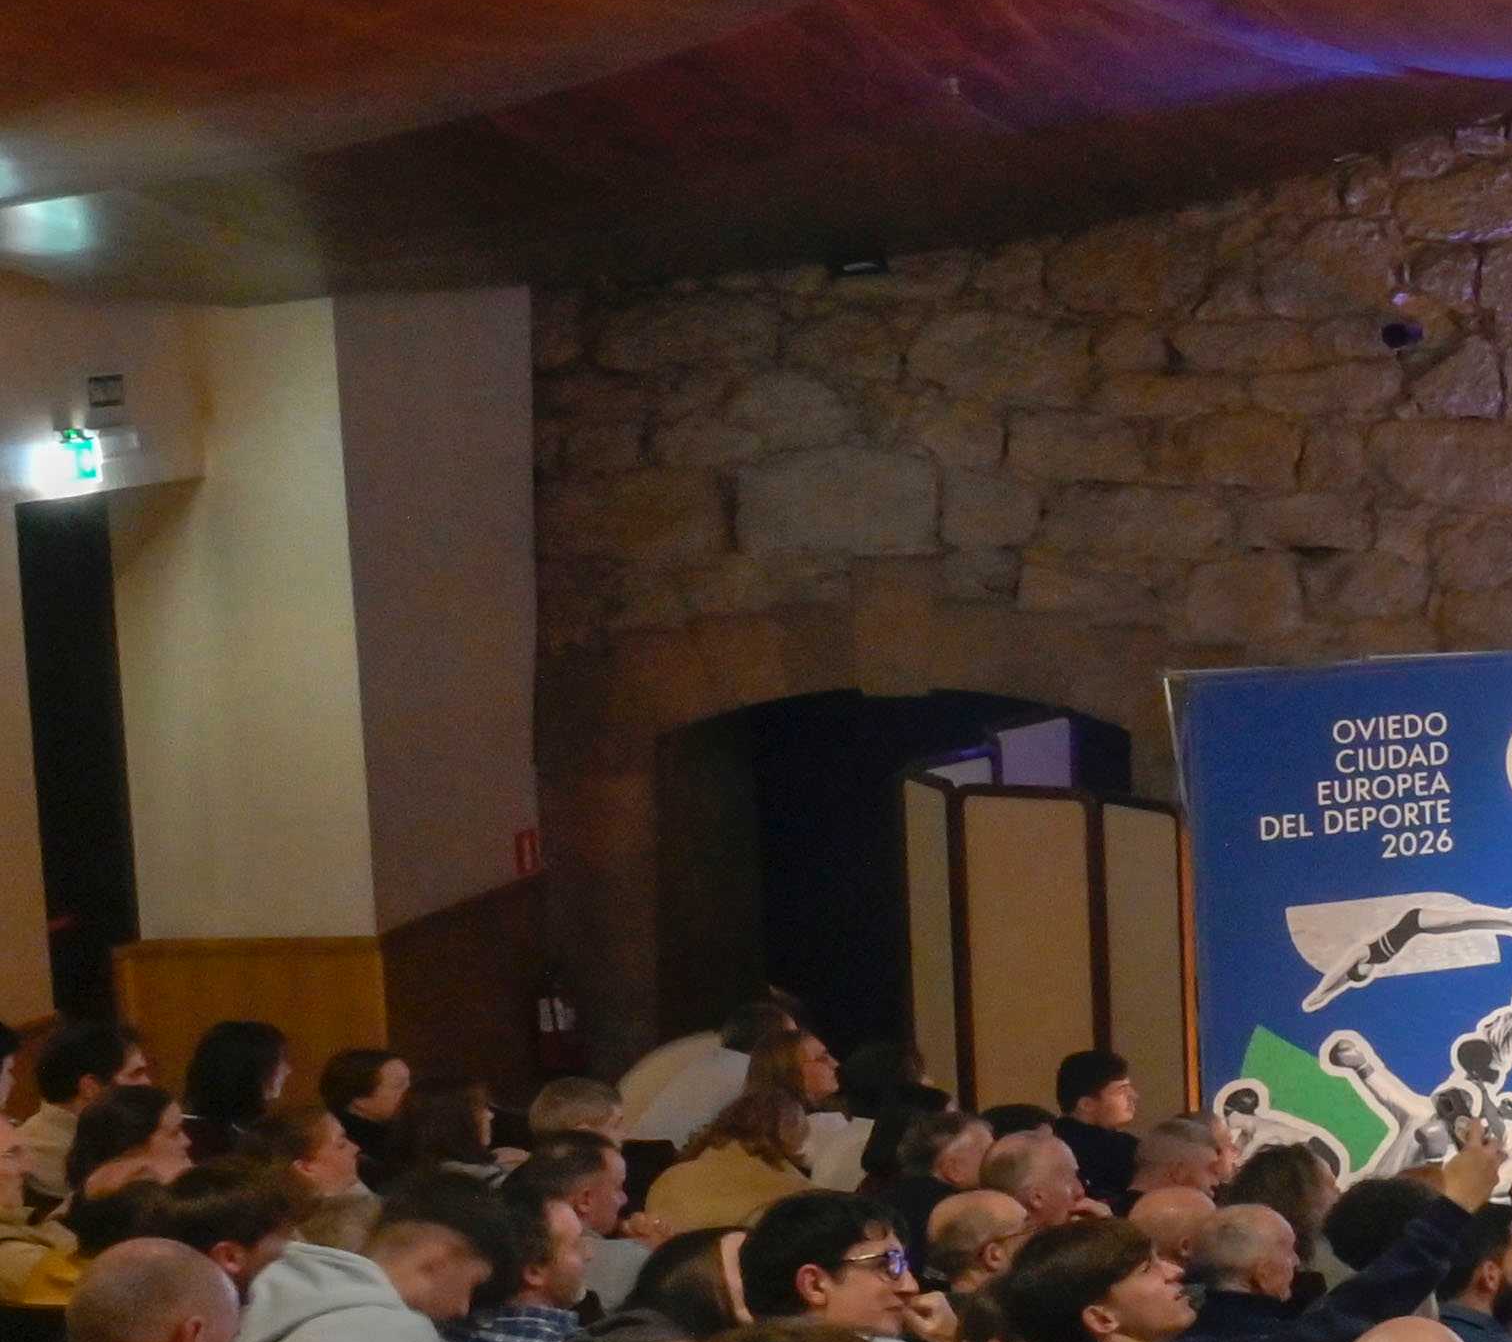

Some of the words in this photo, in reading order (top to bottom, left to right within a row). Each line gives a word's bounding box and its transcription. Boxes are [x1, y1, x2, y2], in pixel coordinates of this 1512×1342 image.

[1332, 712, 1448, 744] OVIEDO
[1335, 741, 1449, 773] CIUDAD
[1317, 771, 1450, 806] EUROPEA
[1260, 813, 1313, 841] DEL
[1323, 799, 1452, 835] DEPORTE
[1381, 828, 1454, 858] 2026
